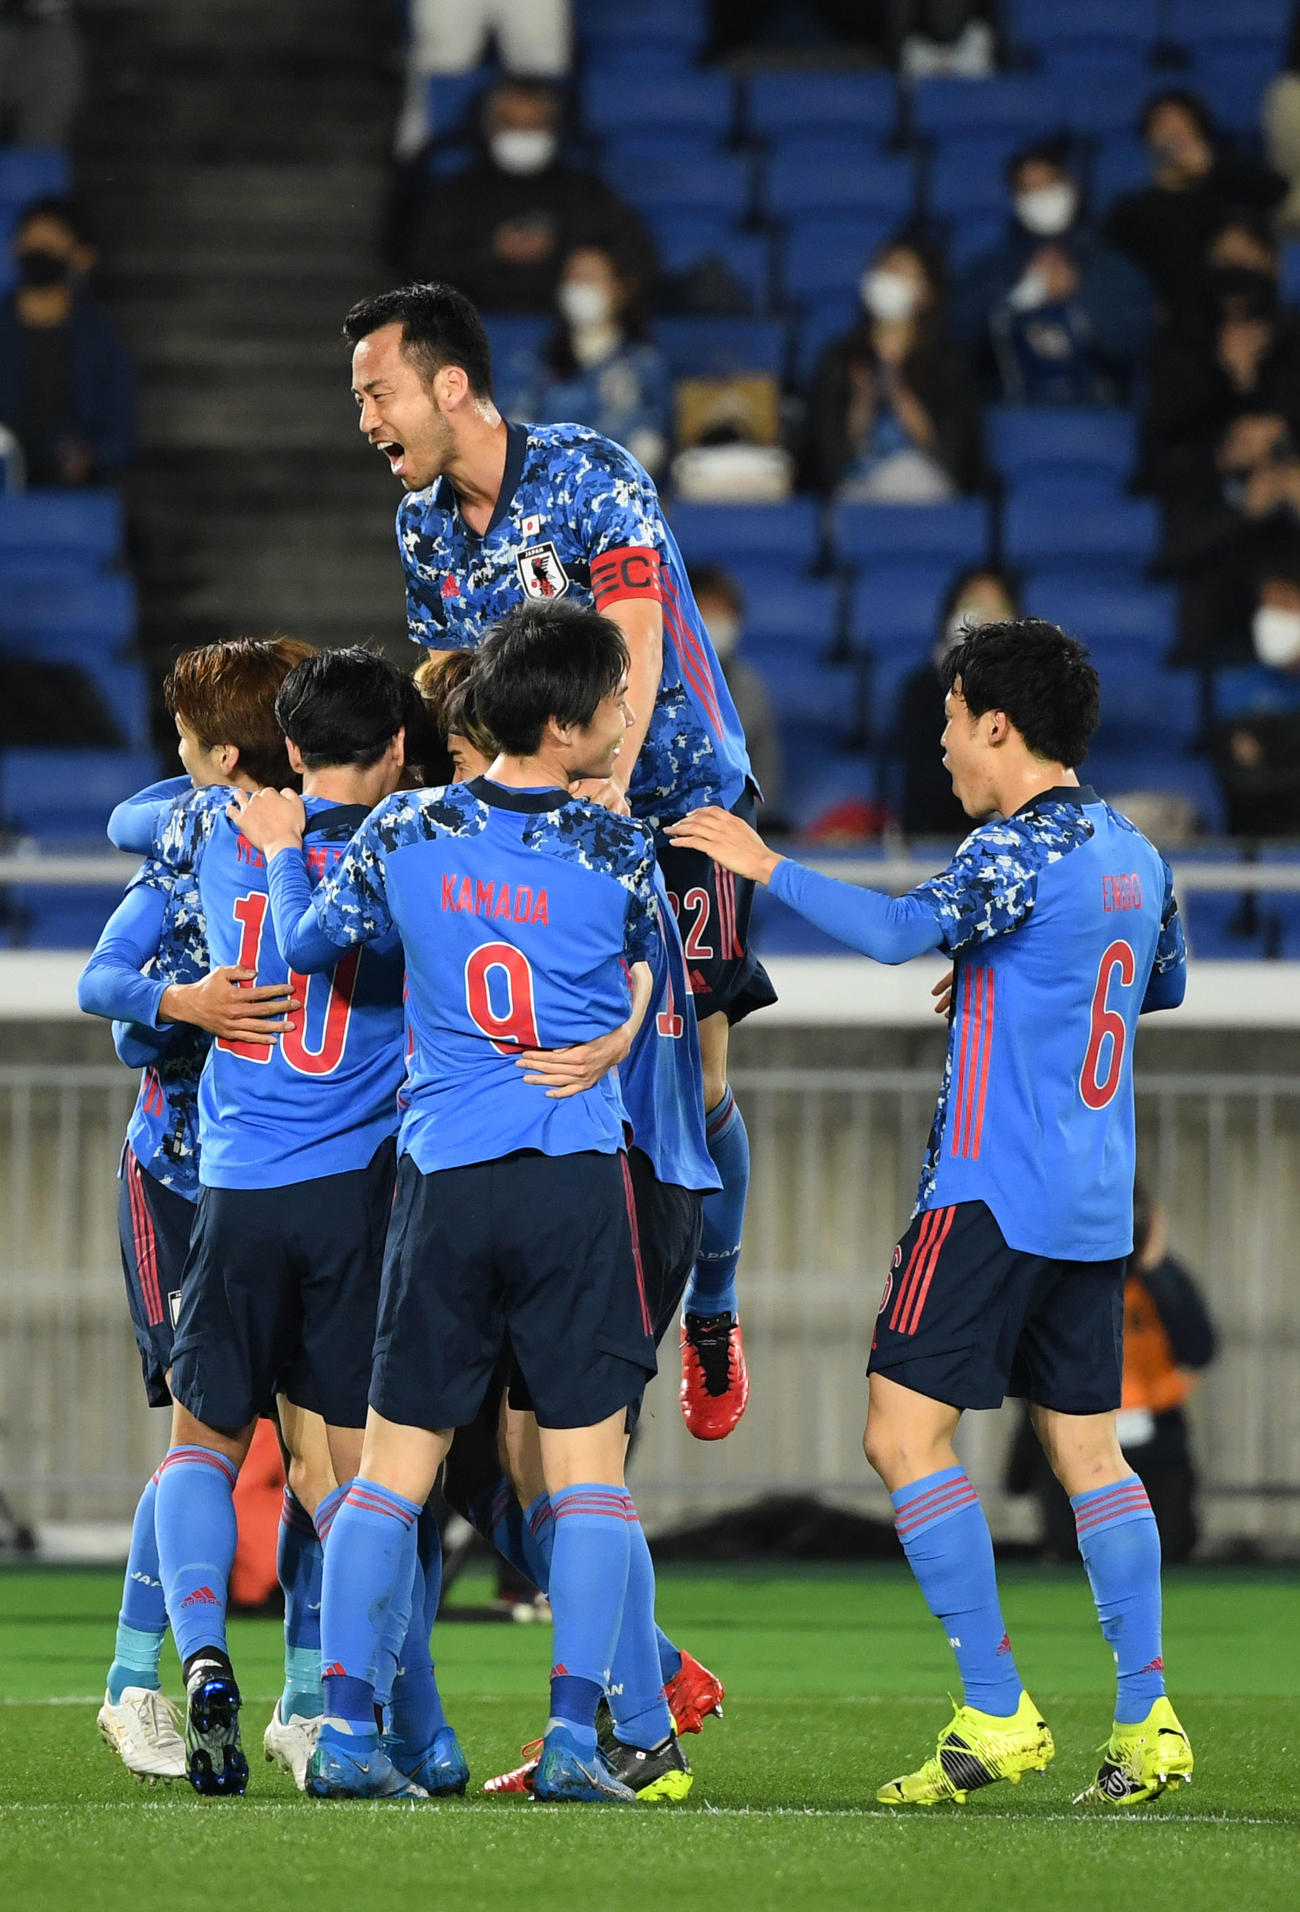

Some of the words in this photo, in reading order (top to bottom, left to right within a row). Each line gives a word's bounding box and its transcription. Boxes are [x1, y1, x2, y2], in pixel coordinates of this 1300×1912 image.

[441, 872, 549, 927] KAMADA
[1101, 872, 1143, 912] ENDO
[215, 890, 363, 1076] 10
[464, 941, 542, 1056] 9
[1078, 939, 1136, 1111] 6
